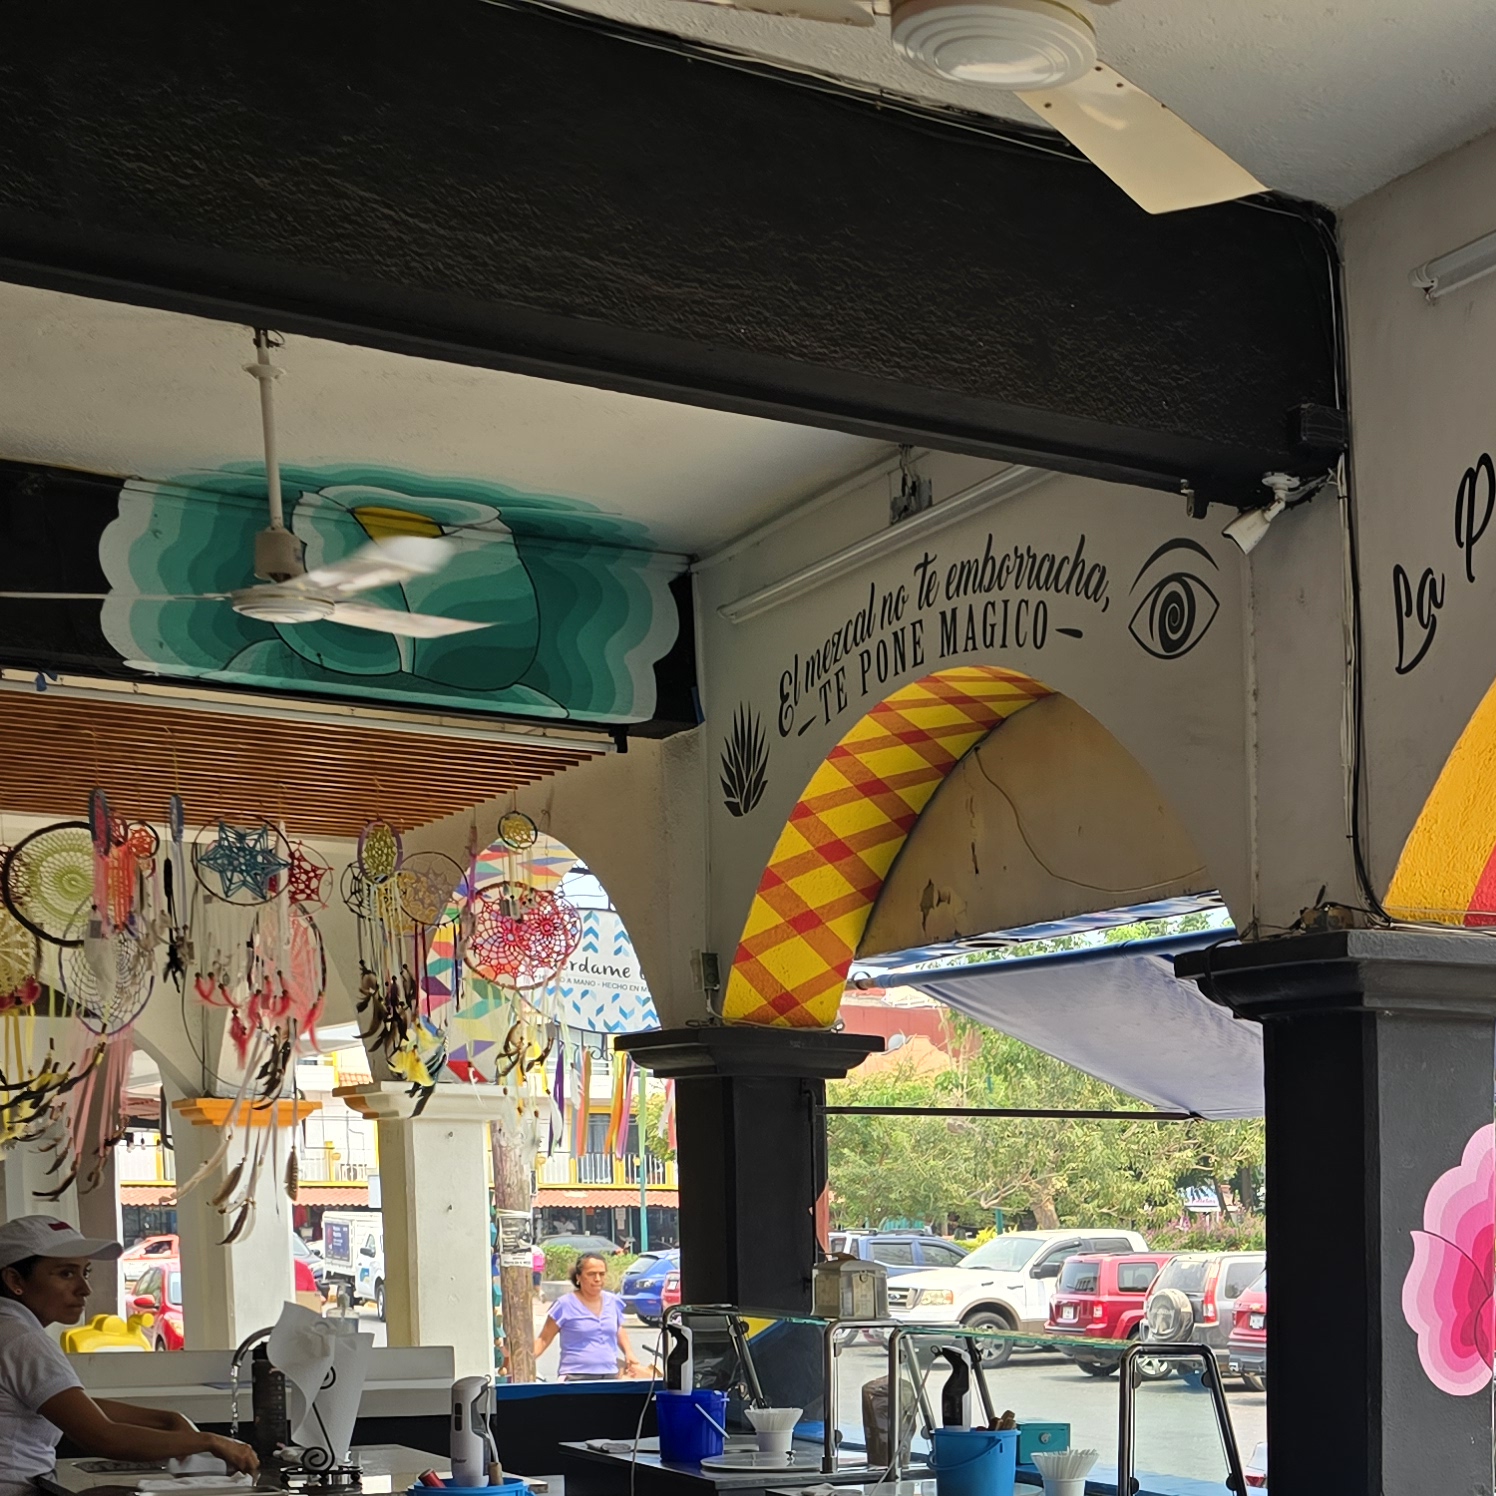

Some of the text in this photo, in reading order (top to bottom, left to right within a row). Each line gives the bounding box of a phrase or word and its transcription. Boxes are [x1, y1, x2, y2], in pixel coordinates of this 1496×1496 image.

[778, 533, 1110, 738] El mezcal no te emborracha,
[818, 598, 1048, 726] TE PONE MAGICO
[1393, 563, 1446, 676] La
[573, 978, 597, 987] MANO
[601, 981, 628, 991] HECHO
[629, 984, 641, 992] EN
